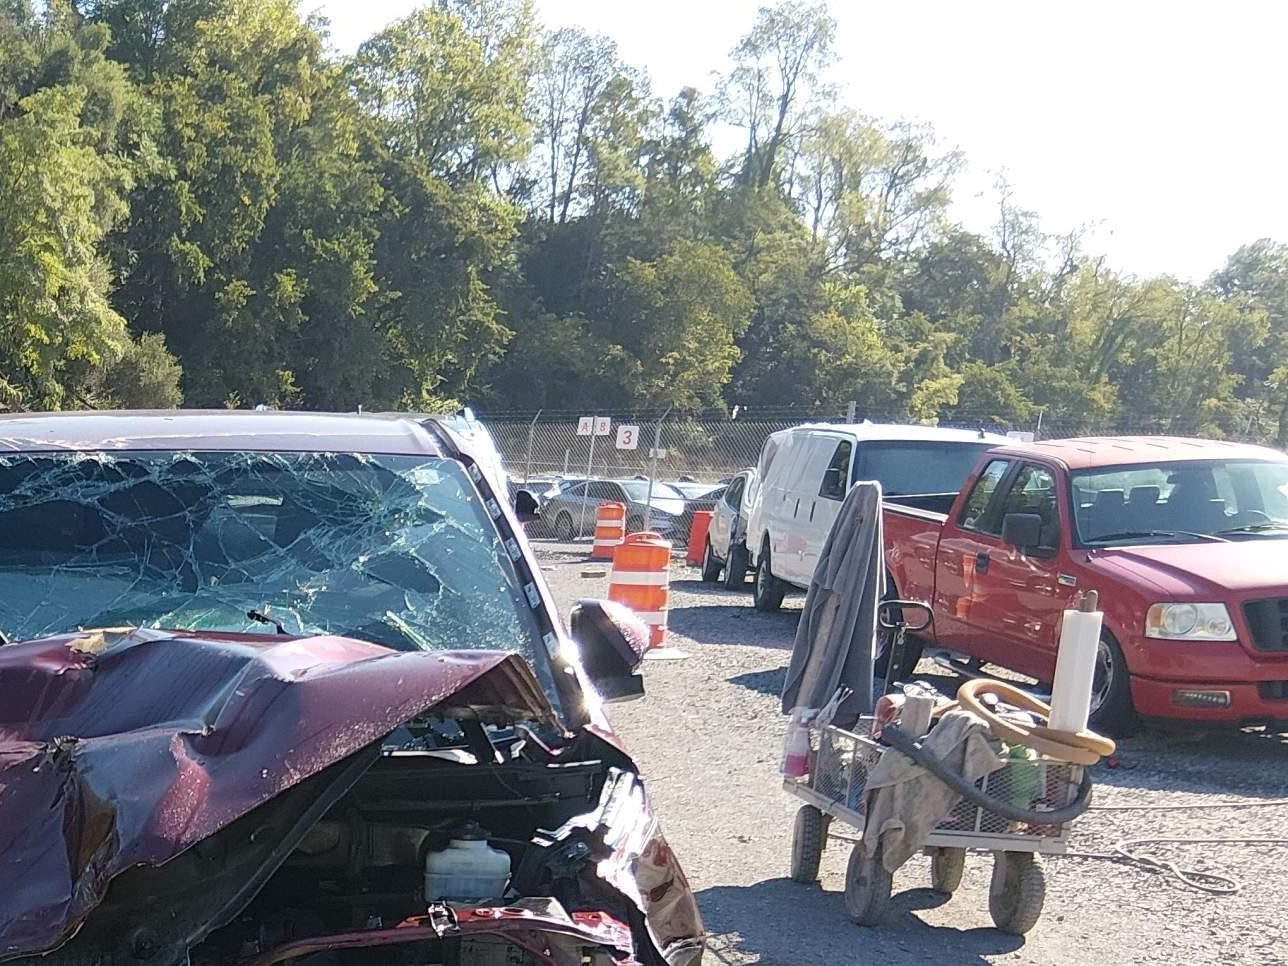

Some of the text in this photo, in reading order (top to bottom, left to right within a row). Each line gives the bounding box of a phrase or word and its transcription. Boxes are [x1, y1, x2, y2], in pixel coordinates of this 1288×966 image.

[581, 422, 589, 432] A
[599, 422, 606, 432] B
[622, 430, 633, 445] 3
